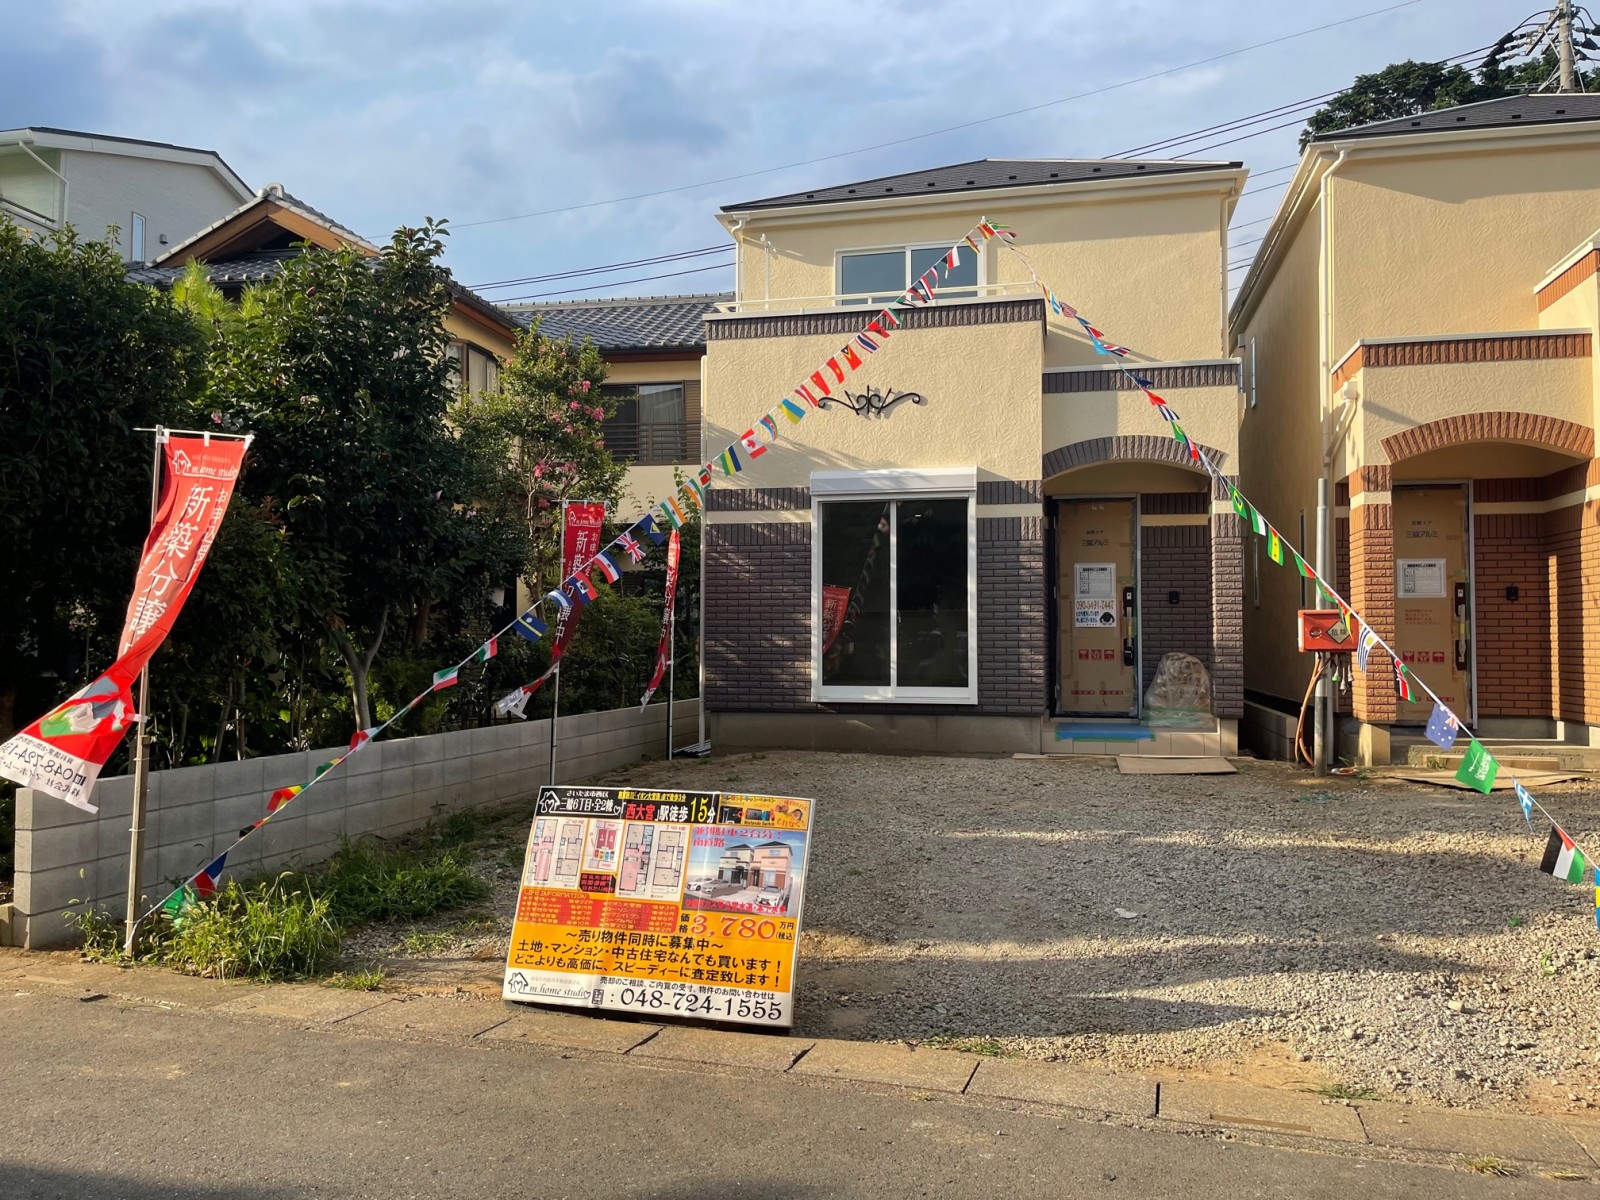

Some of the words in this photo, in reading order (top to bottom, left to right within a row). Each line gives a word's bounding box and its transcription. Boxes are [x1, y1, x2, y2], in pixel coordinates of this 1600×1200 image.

[1331, 628, 1348, 637] 危険
[679, 914, 690, 934] 価格
[690, 914, 776, 940] 3,780
[779, 921, 795, 930] 万円
